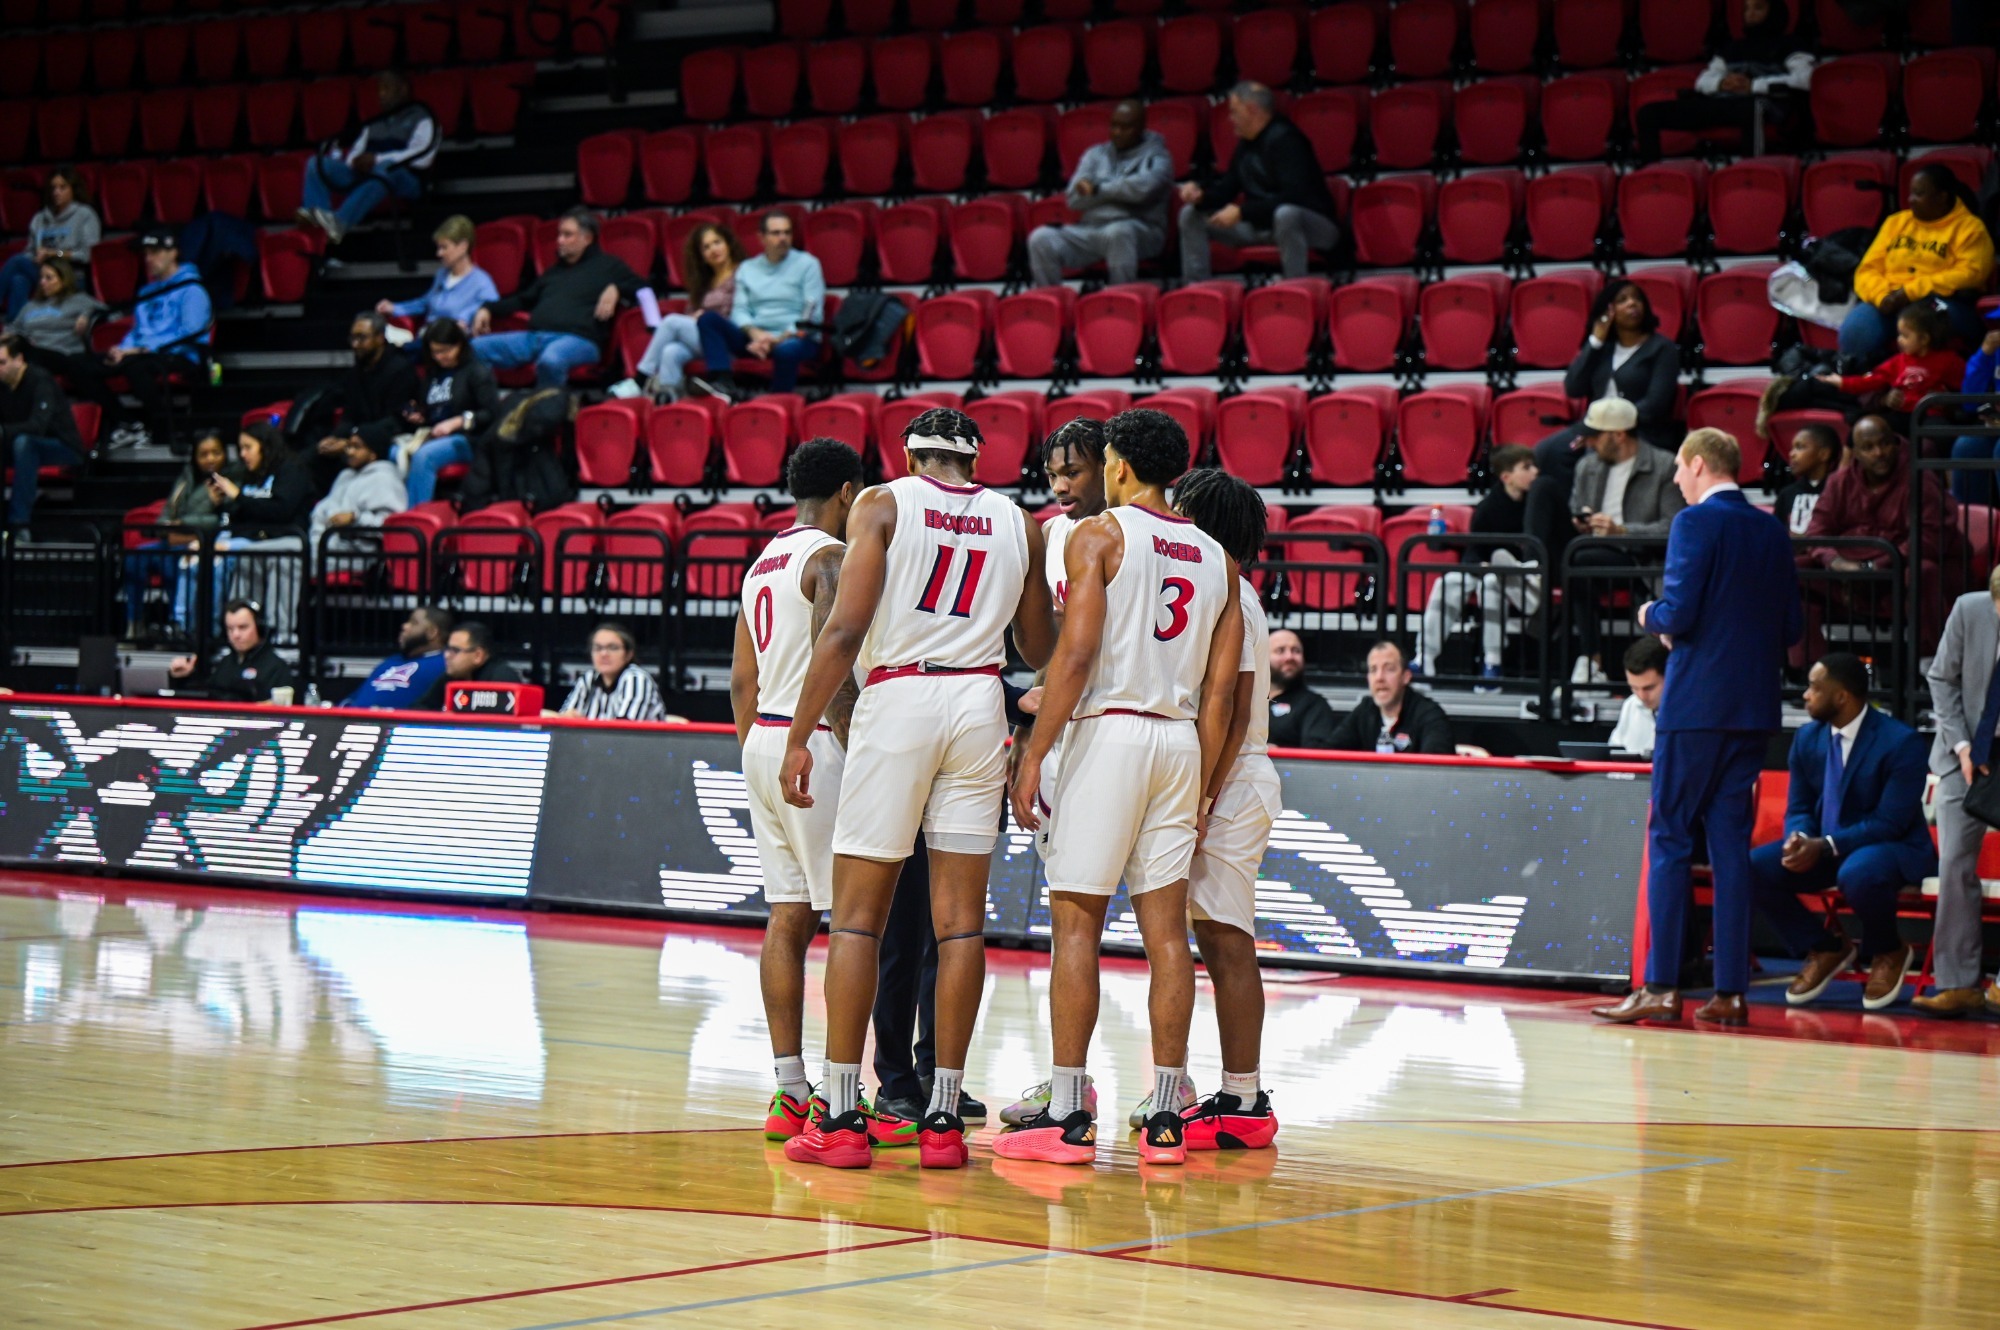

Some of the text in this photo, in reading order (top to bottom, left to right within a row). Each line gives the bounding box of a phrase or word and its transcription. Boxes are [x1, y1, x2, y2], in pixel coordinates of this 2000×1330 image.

[914, 543, 988, 619] 11
[1152, 534, 1202, 564] ROGERS
[754, 585, 773, 654] 0
[1153, 575, 1195, 642] 3
